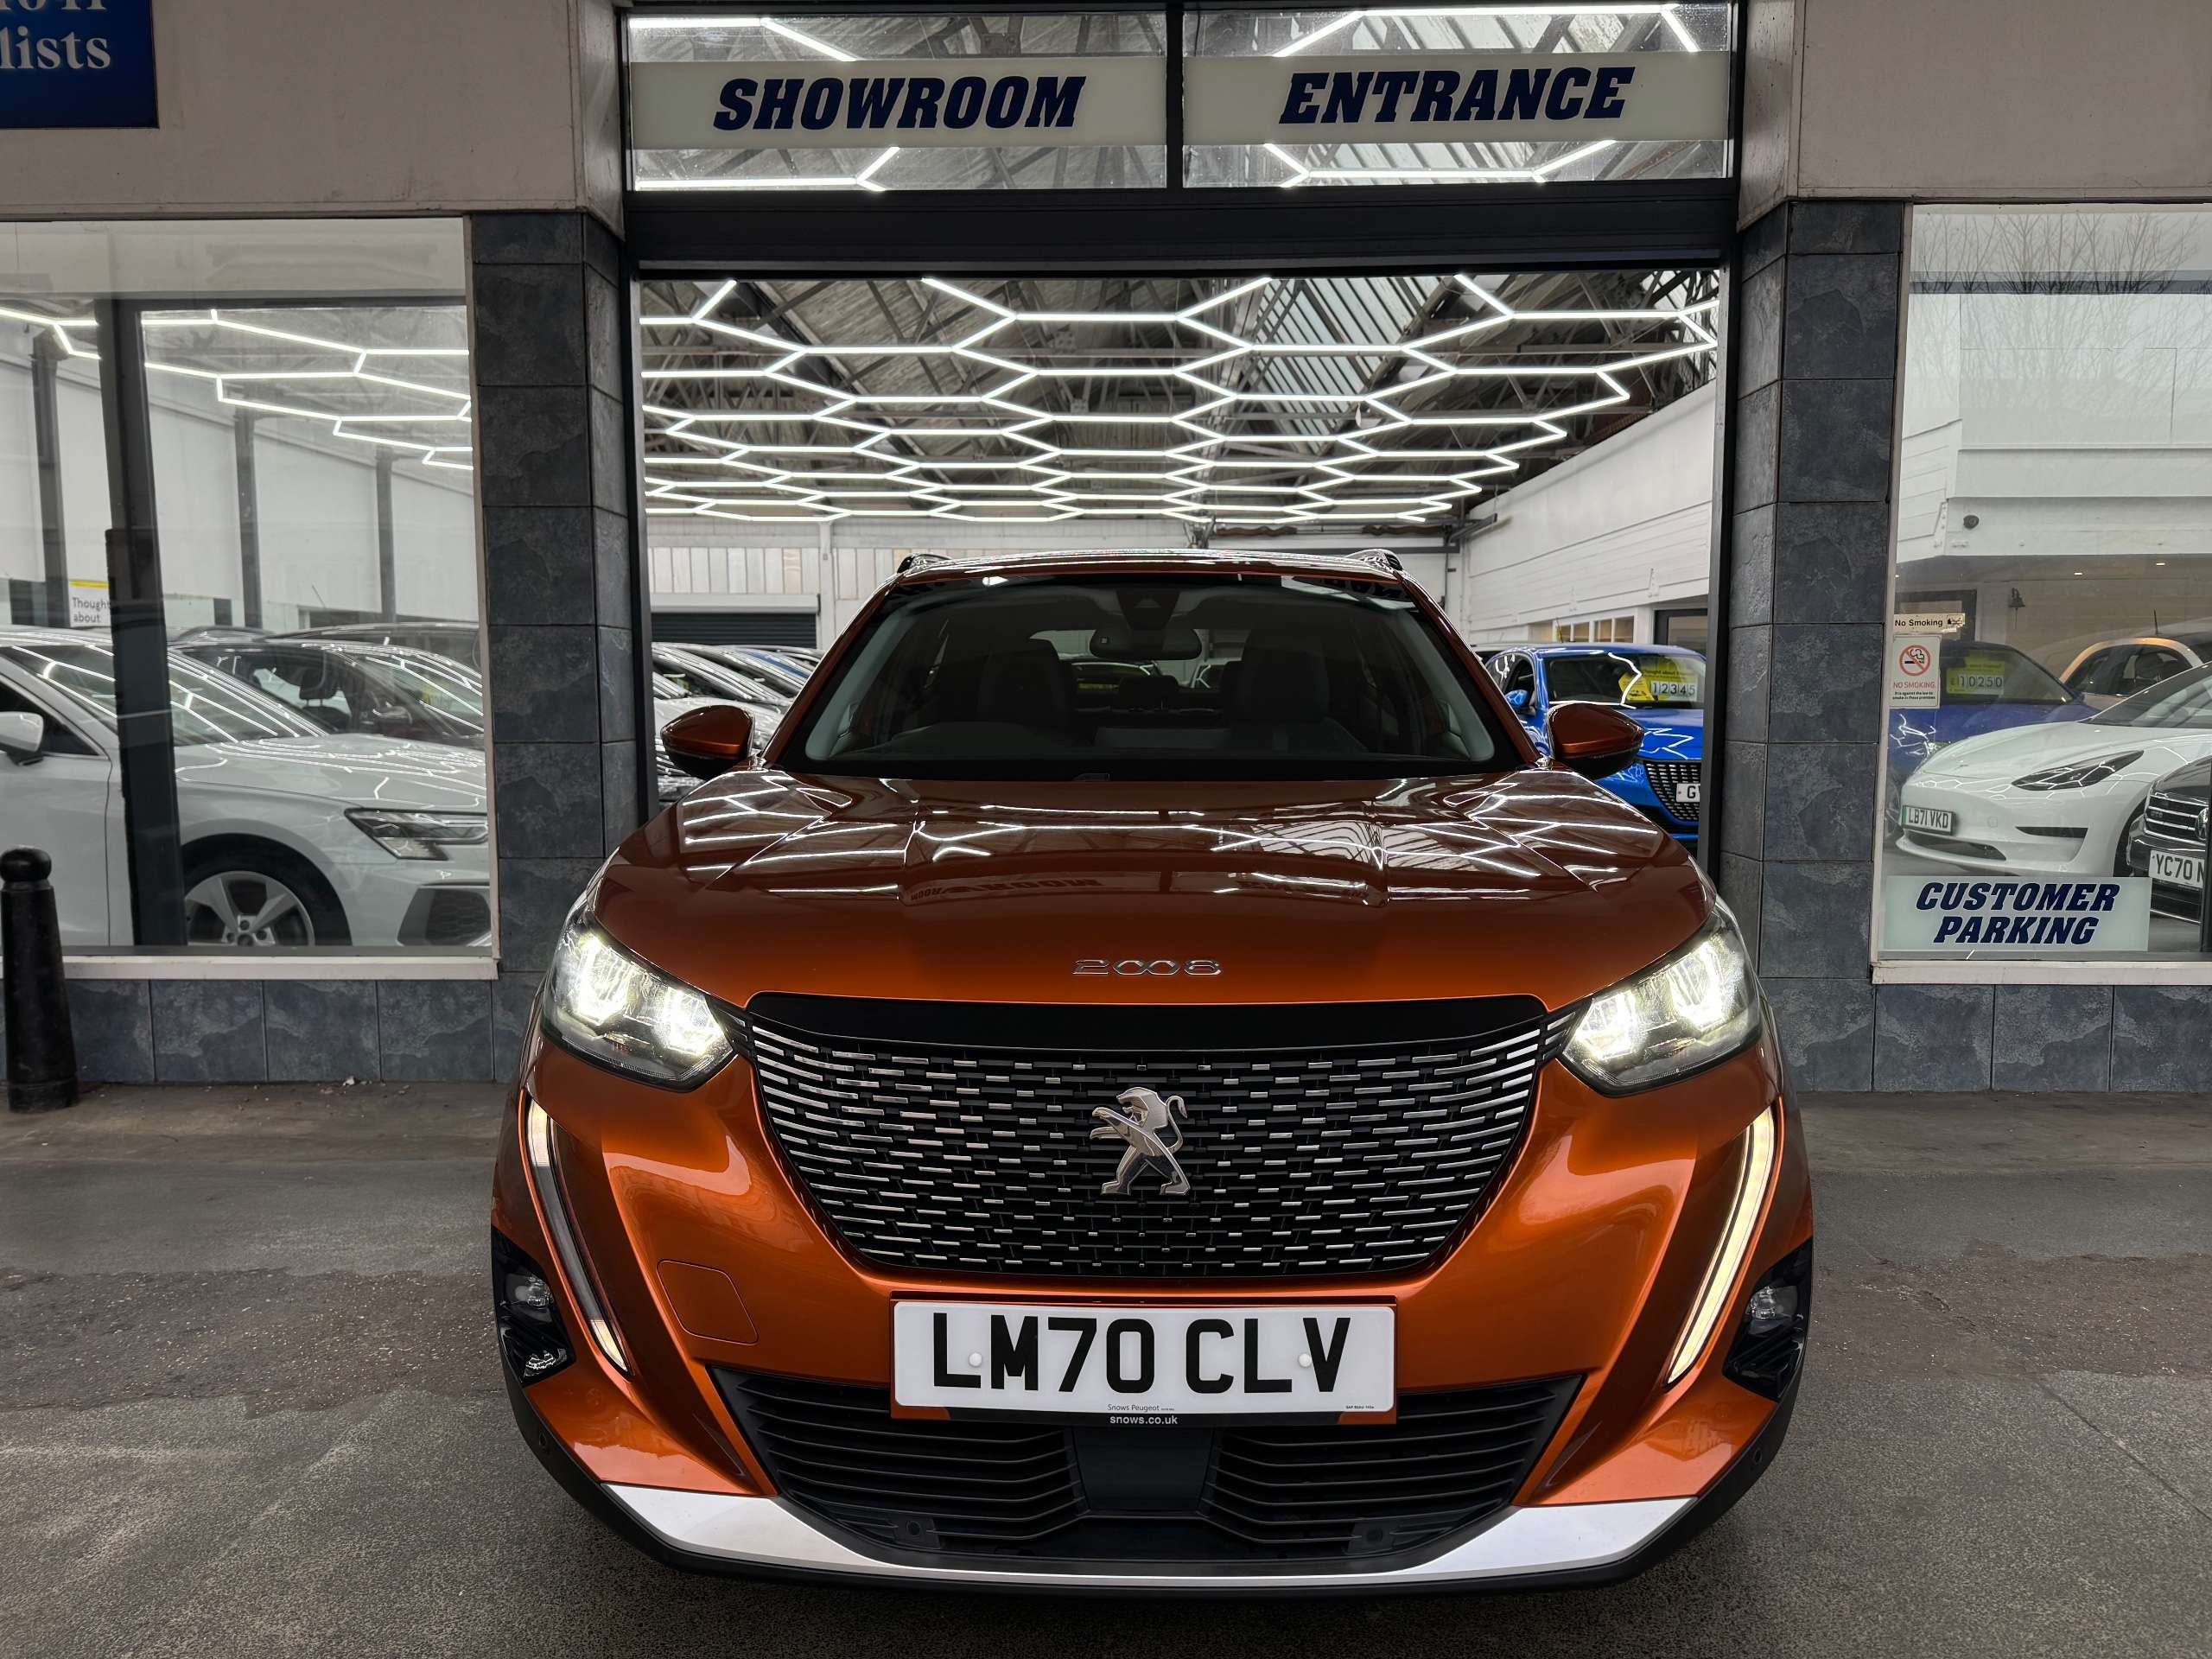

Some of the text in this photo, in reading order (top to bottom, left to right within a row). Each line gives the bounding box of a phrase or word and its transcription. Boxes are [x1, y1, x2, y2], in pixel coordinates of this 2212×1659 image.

[713, 66, 1636, 130] SHOWROOM ENTRANCE
[73, 612, 101, 623] about
[1908, 619, 1943, 627] Smoking
[1688, 785, 1700, 799] G
[1908, 808, 1948, 829] LB71 VKD
[2156, 853, 2193, 880] YC70
[1916, 881, 2120, 912] CUSTOMER
[1933, 916, 2100, 944] PARKING
[1072, 959, 1222, 976] 2008
[932, 1312, 1351, 1394] LM70 CLV
[1131, 1404, 1160, 1413] Peugeot
[1109, 1414, 1178, 1425] snows.co.uk
